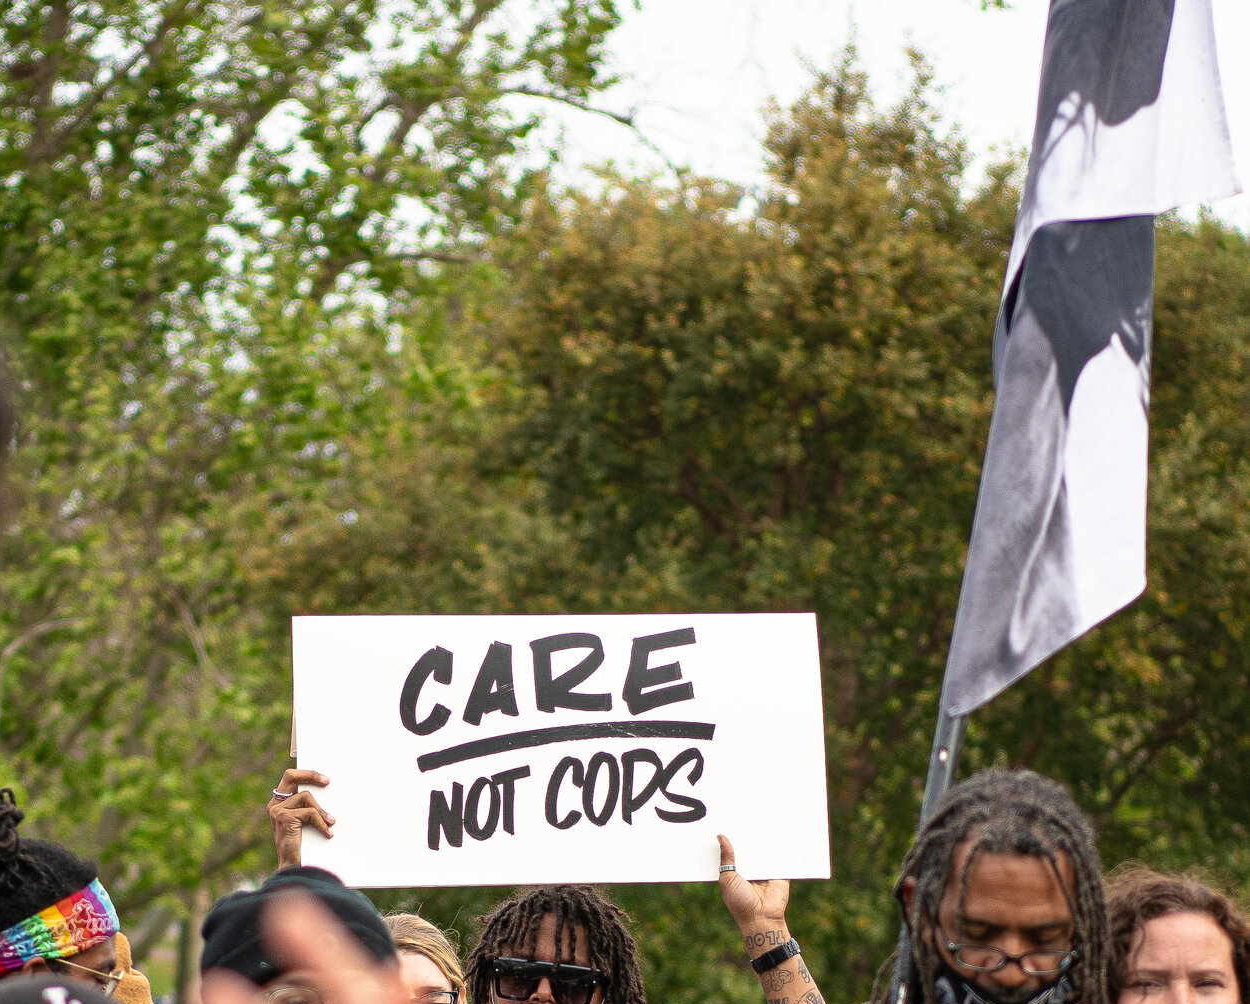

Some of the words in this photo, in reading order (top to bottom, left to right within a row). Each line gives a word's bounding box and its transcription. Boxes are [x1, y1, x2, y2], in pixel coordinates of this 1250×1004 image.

[399, 627, 696, 736] CARE
[427, 765, 531, 851] NOT
[545, 748, 707, 830] COPS
